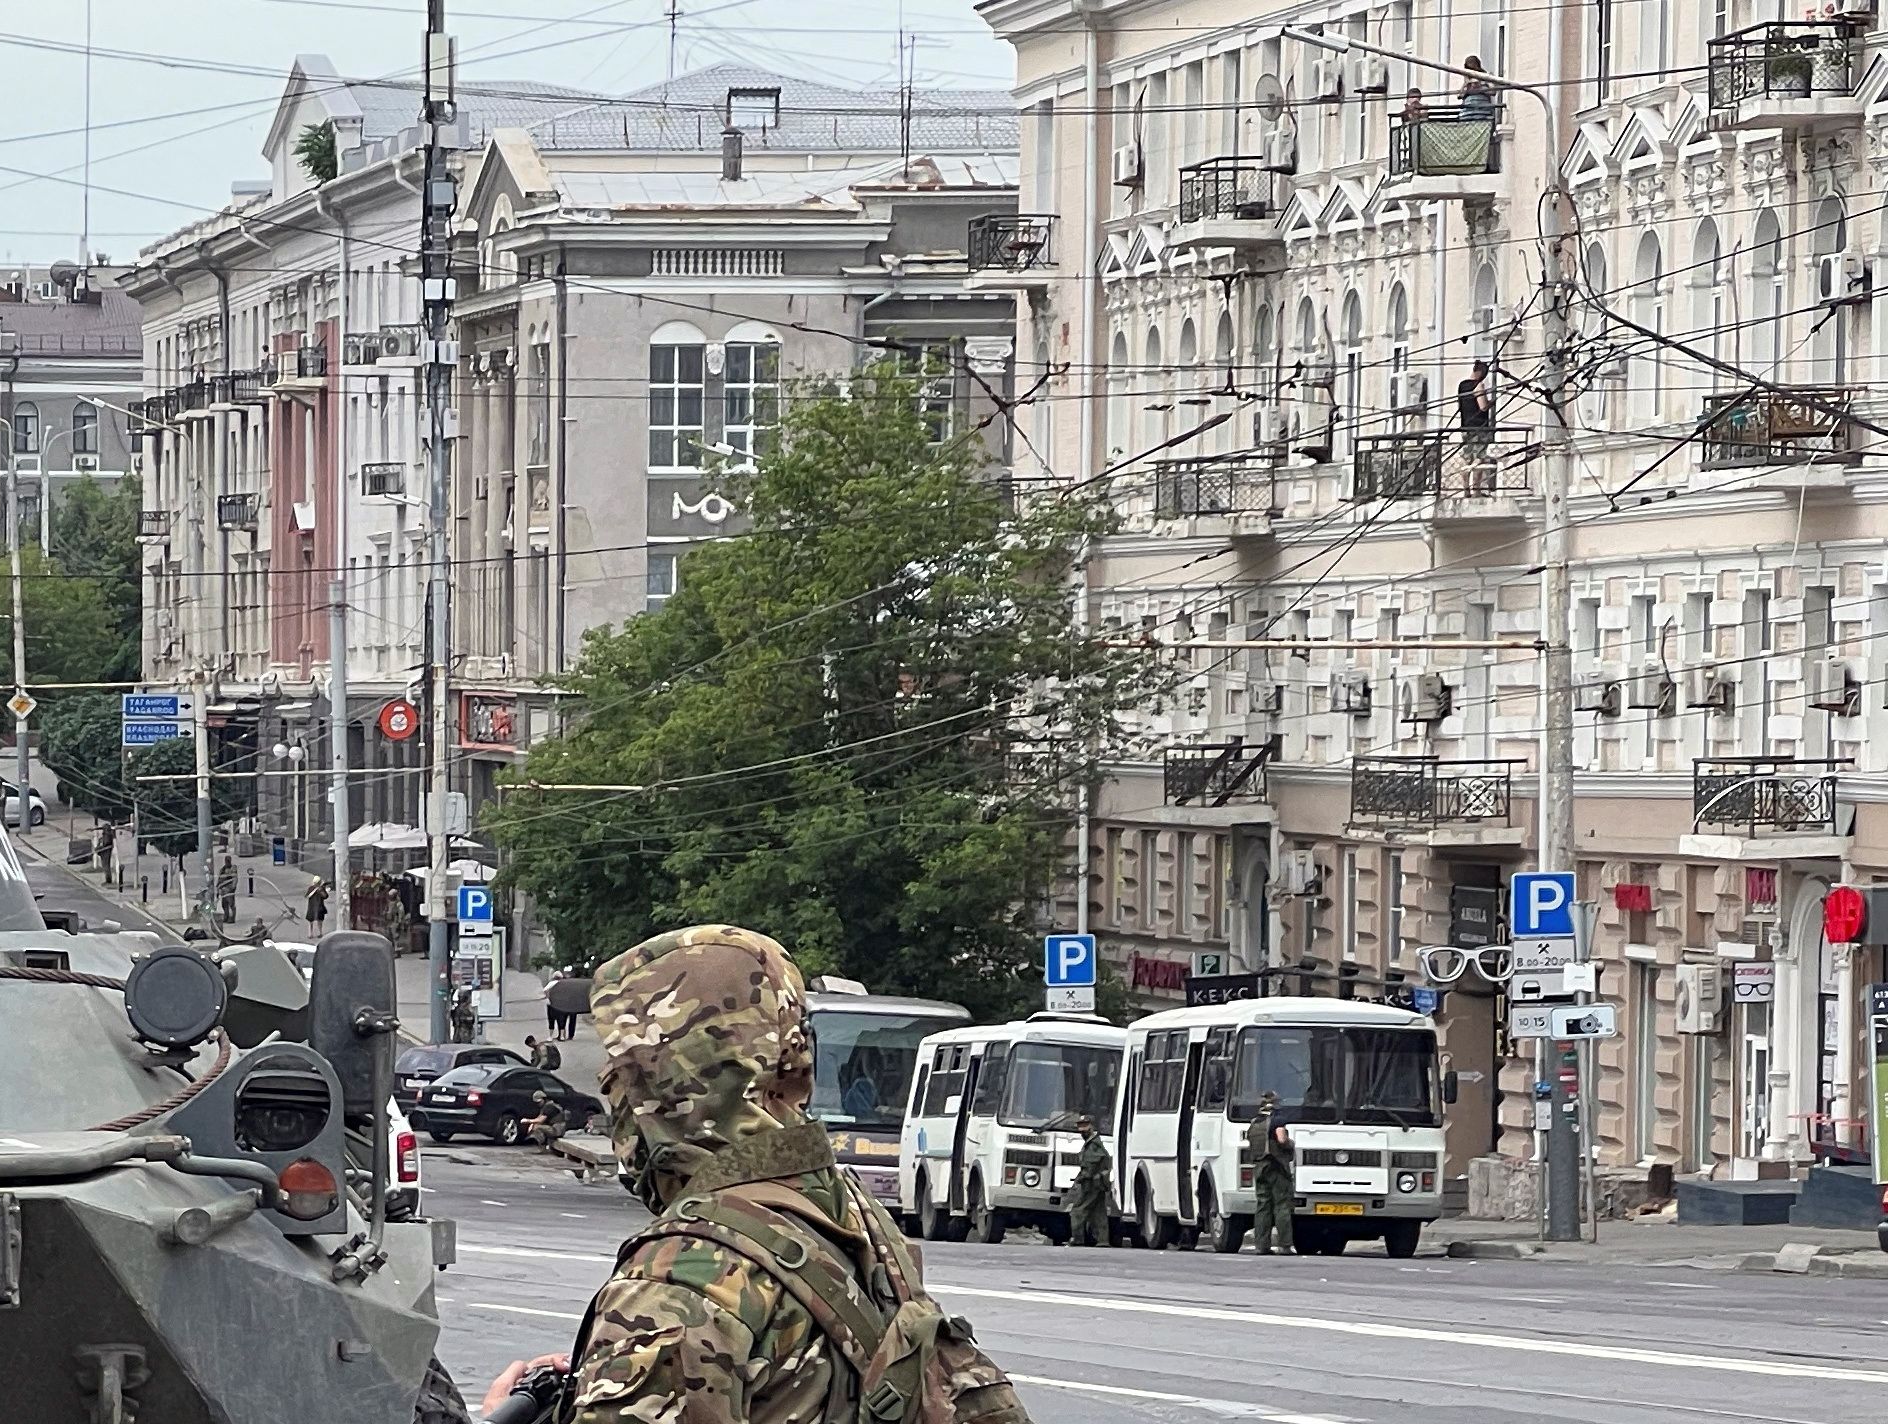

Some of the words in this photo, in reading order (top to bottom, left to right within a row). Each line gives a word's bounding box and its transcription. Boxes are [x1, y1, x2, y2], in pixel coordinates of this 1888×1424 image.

[467, 890, 487, 917] P
[1529, 880, 1565, 929] P
[1059, 940, 1087, 980] P
